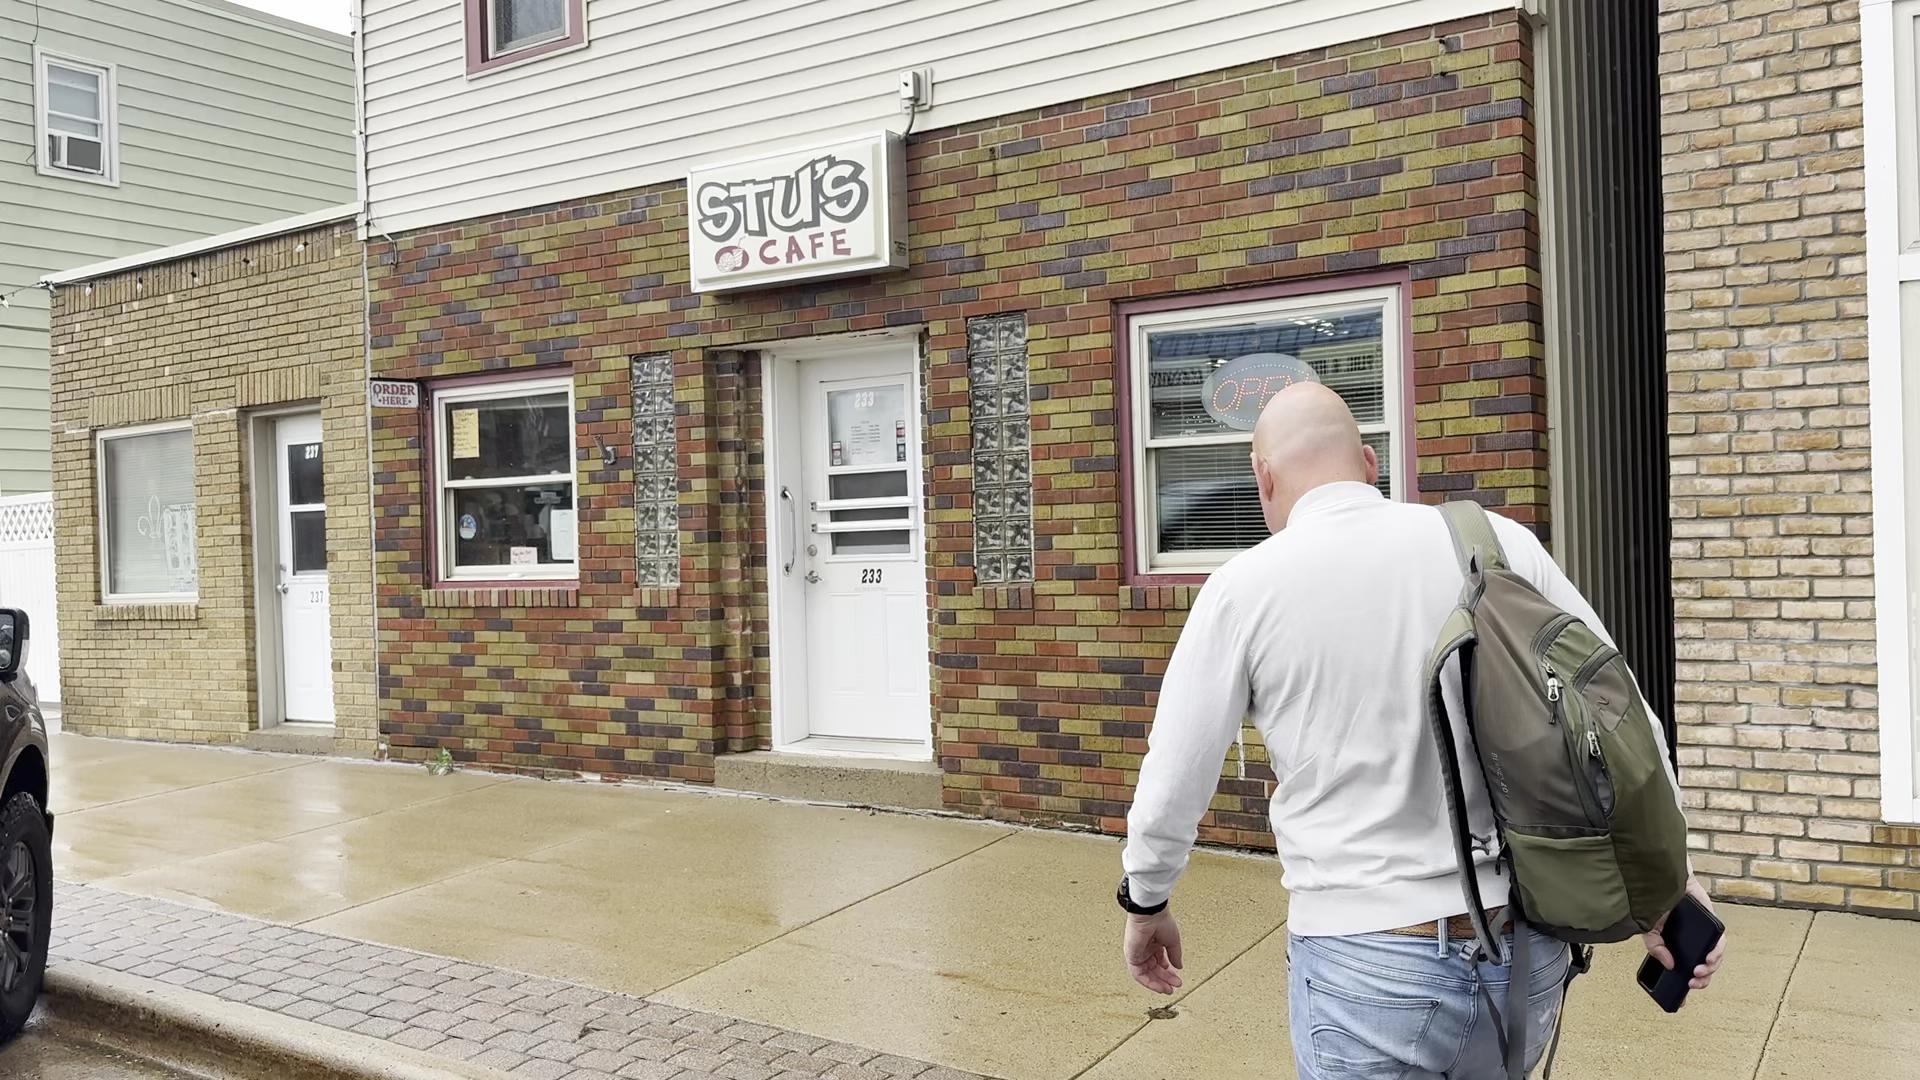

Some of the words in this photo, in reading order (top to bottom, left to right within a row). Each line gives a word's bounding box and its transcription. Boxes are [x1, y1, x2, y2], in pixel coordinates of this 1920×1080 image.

[697, 154, 869, 243] STU'S
[759, 228, 852, 265] CAFE
[372, 383, 416, 396] ORDER
[1213, 374, 1311, 412] OPE
[382, 396, 409, 406] HERE
[854, 391, 874, 408] 233
[304, 445, 319, 460] 237
[861, 568, 882, 584] 233
[310, 590, 324, 603] 237
